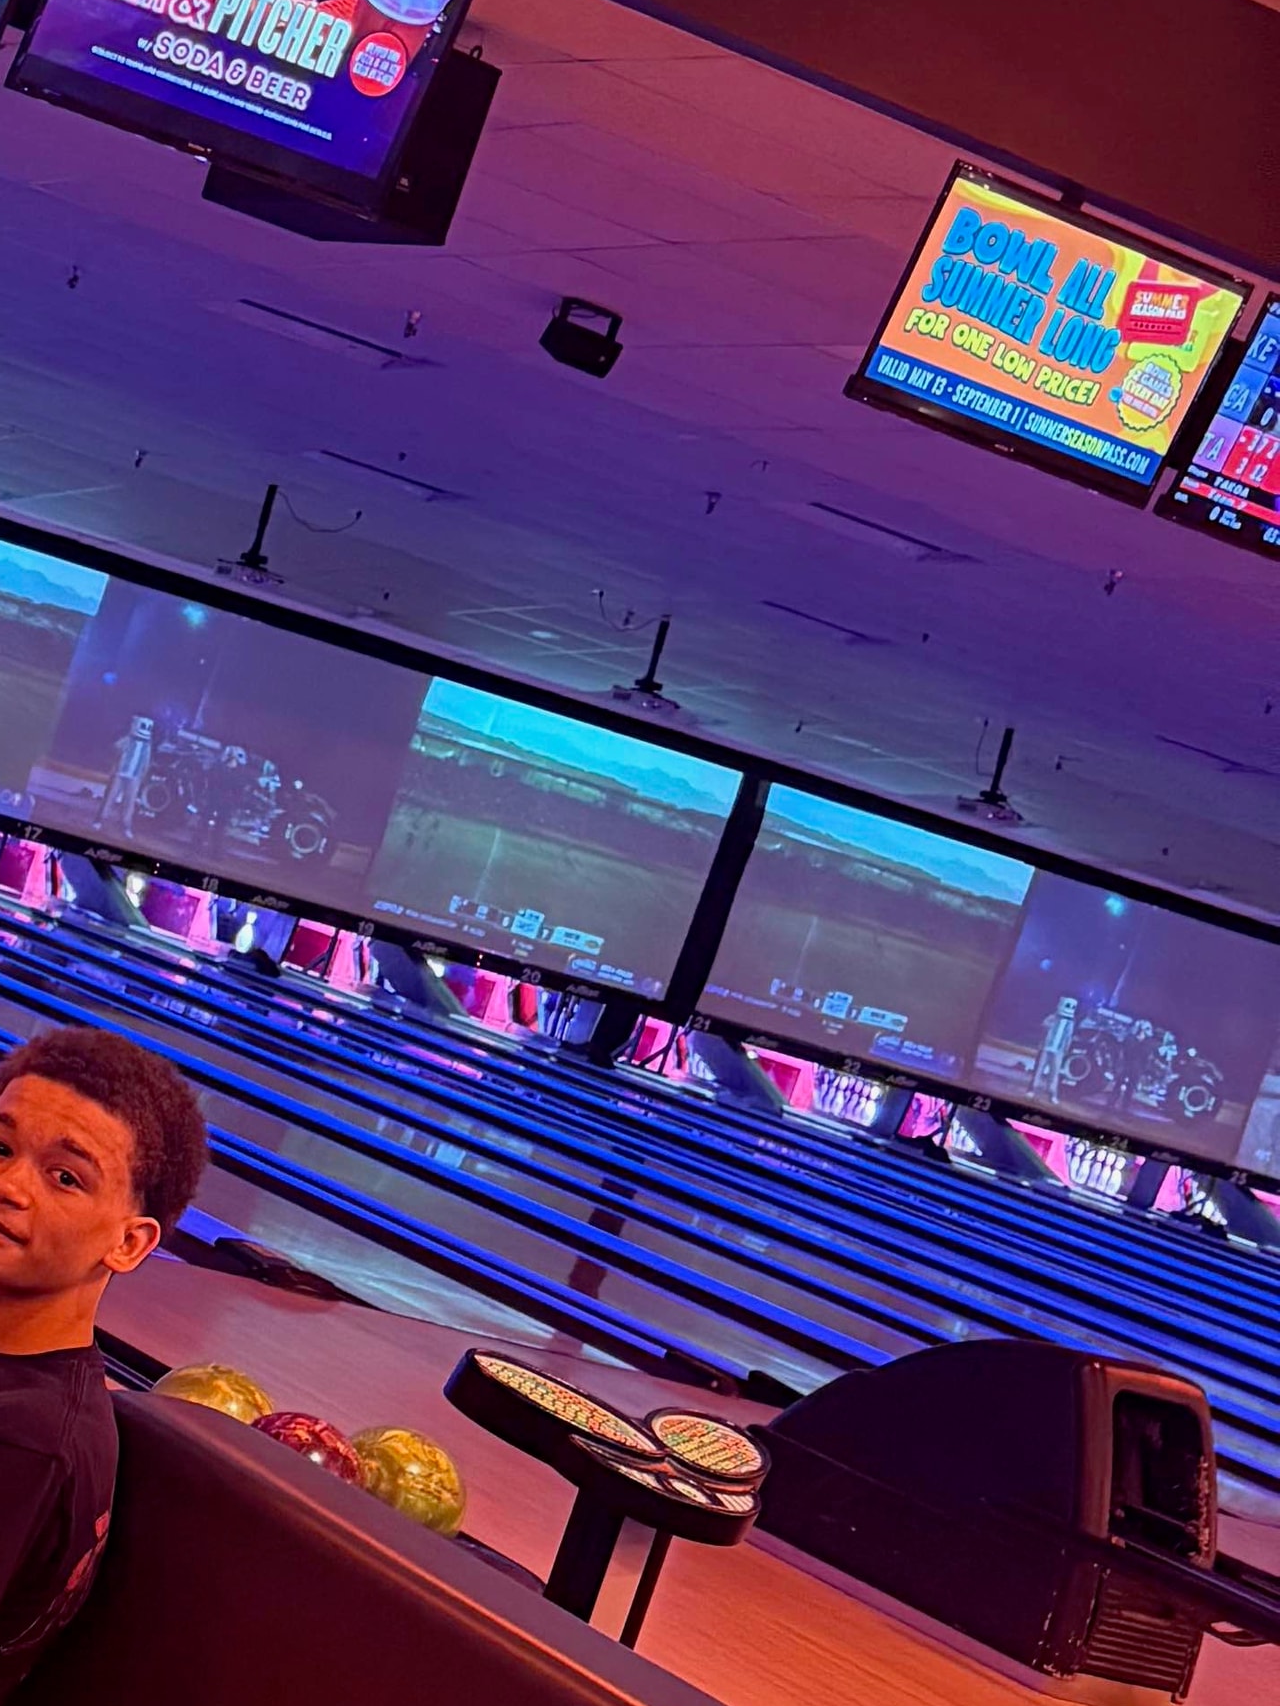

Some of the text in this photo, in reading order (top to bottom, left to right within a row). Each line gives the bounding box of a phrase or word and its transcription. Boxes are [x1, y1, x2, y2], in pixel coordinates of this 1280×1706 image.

[153, 31, 224, 80] SODA
[226, 59, 246, 85] &
[245, 66, 312, 112] BEER
[942, 206, 1117, 320] BOWL ALL
[922, 255, 1121, 374] SUMMER LONG
[1134, 291, 1189, 310] SUMMER
[904, 308, 950, 340] FOR
[952, 323, 994, 360] ONE
[992, 343, 1036, 383] LOW
[1034, 365, 1101, 406] PRICE!
[878, 354, 909, 381] VALID
[908, 366, 935, 390] MAY
[952, 383, 1010, 420] SEPTEMBER
[1223, 383, 1249, 412] CA
[1198, 432, 1224, 463] TA
[24, 825, 41, 840] 17
[202, 876, 219, 892] 18
[521, 967, 541, 983] 20
